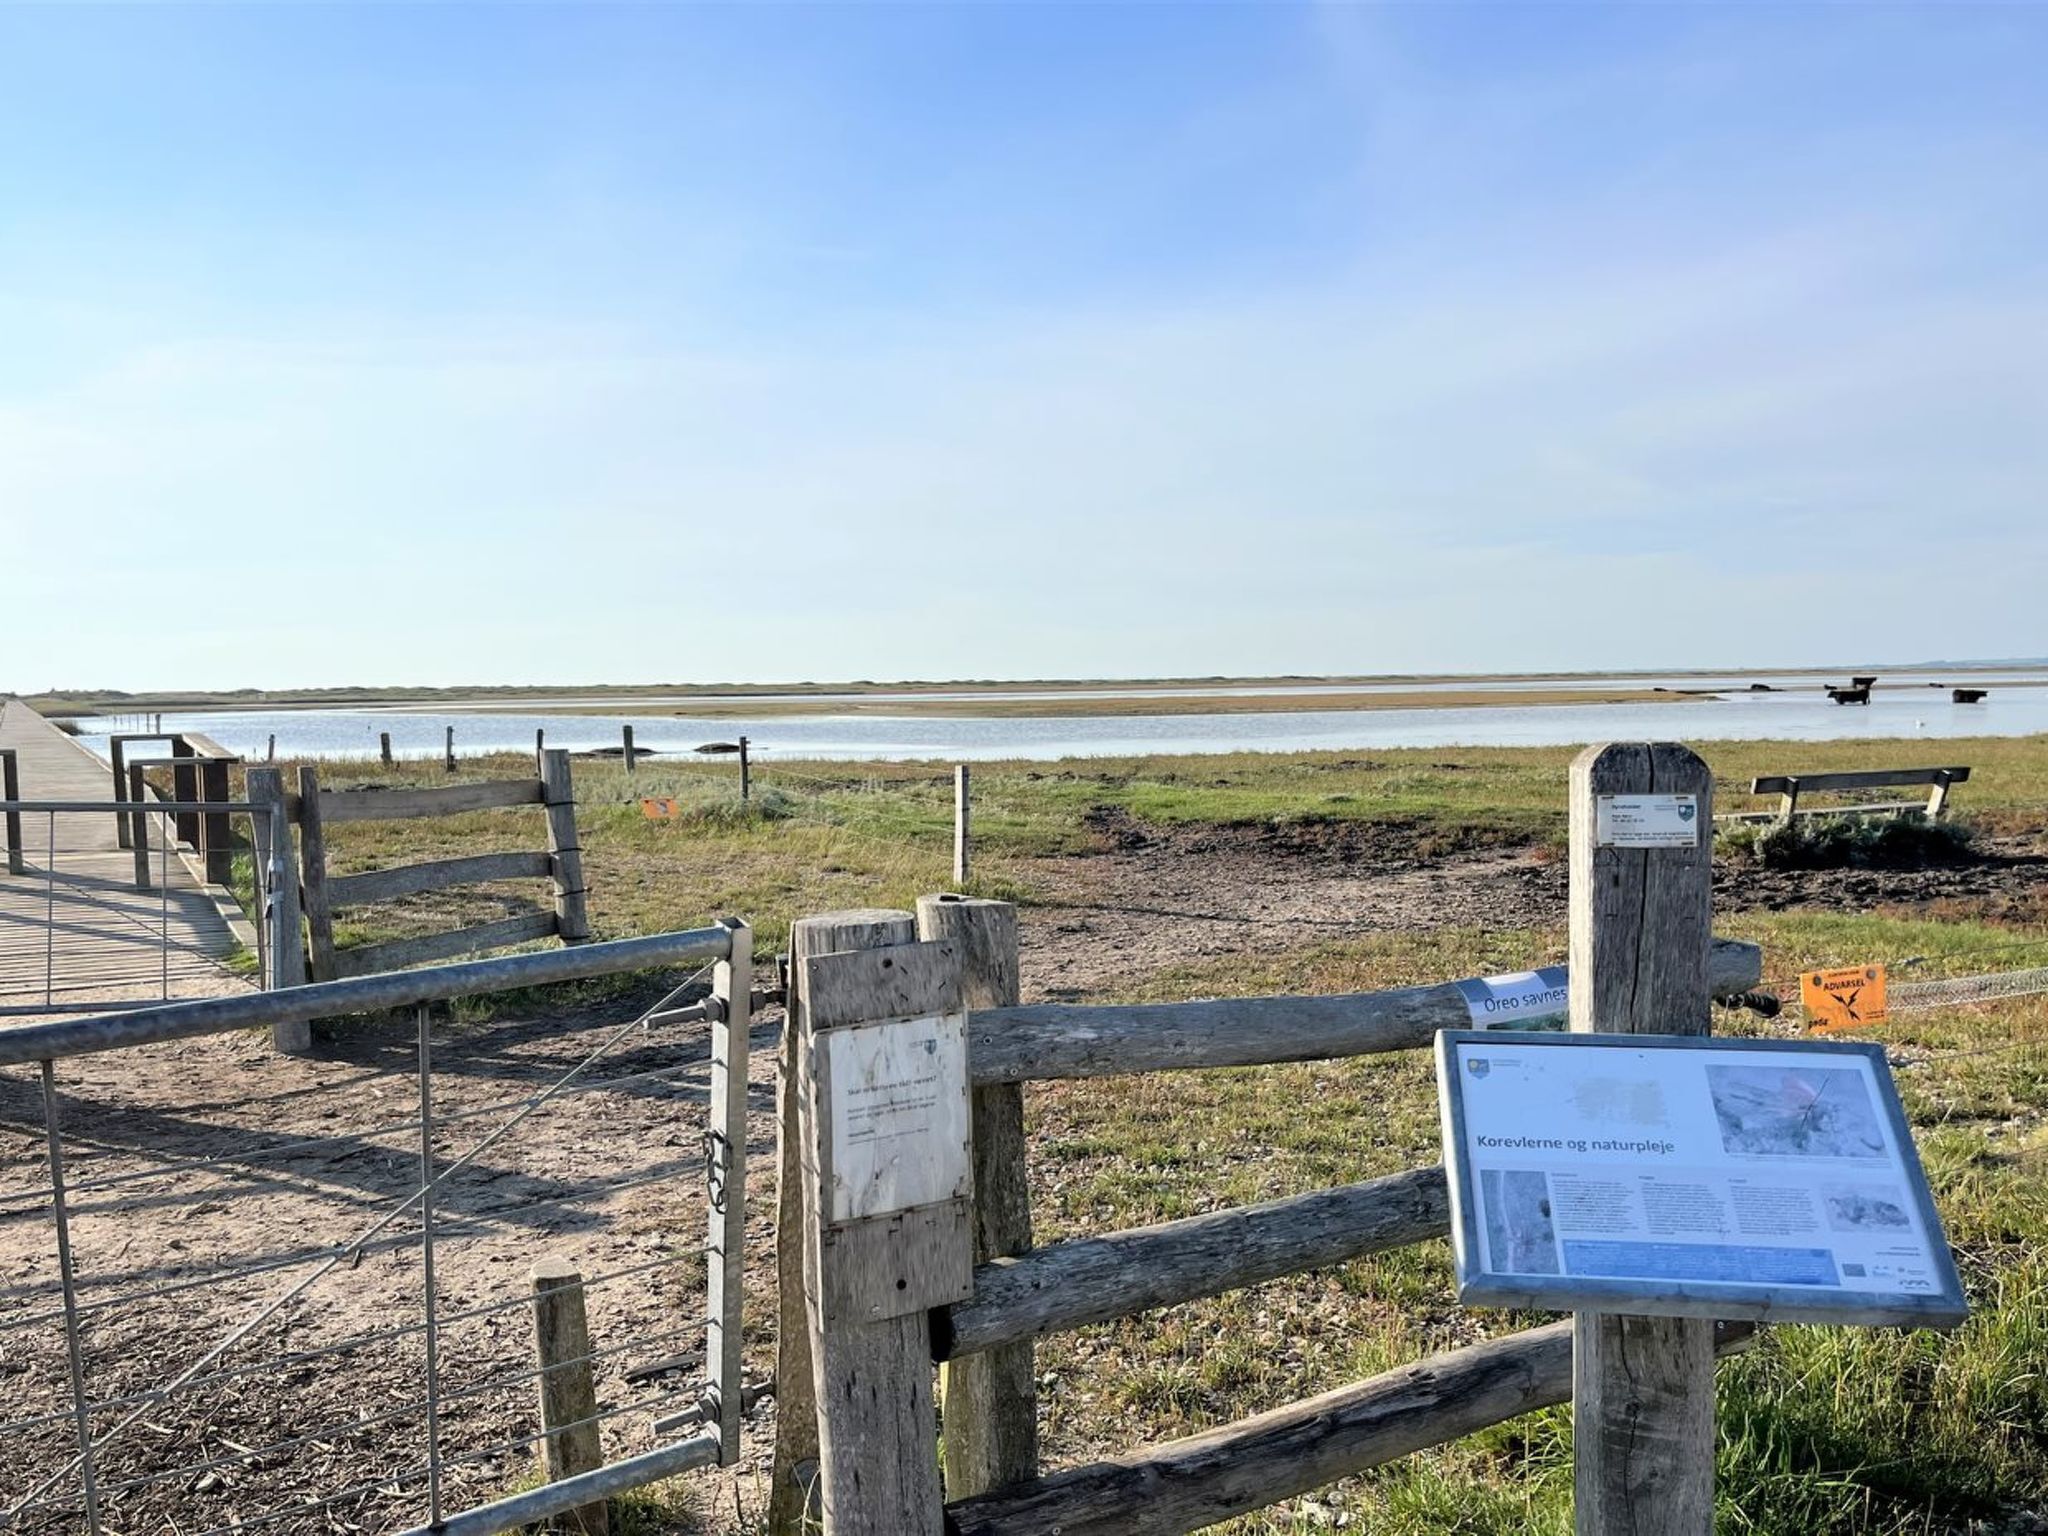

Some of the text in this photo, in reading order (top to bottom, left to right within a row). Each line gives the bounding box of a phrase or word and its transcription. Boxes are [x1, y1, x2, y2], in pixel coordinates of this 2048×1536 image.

[1823, 979, 1866, 991] ADVARSEL
[1484, 988, 1568, 1012] Oreo savnes
[1477, 1135, 1675, 1155] Korevlerne og naturpleje
